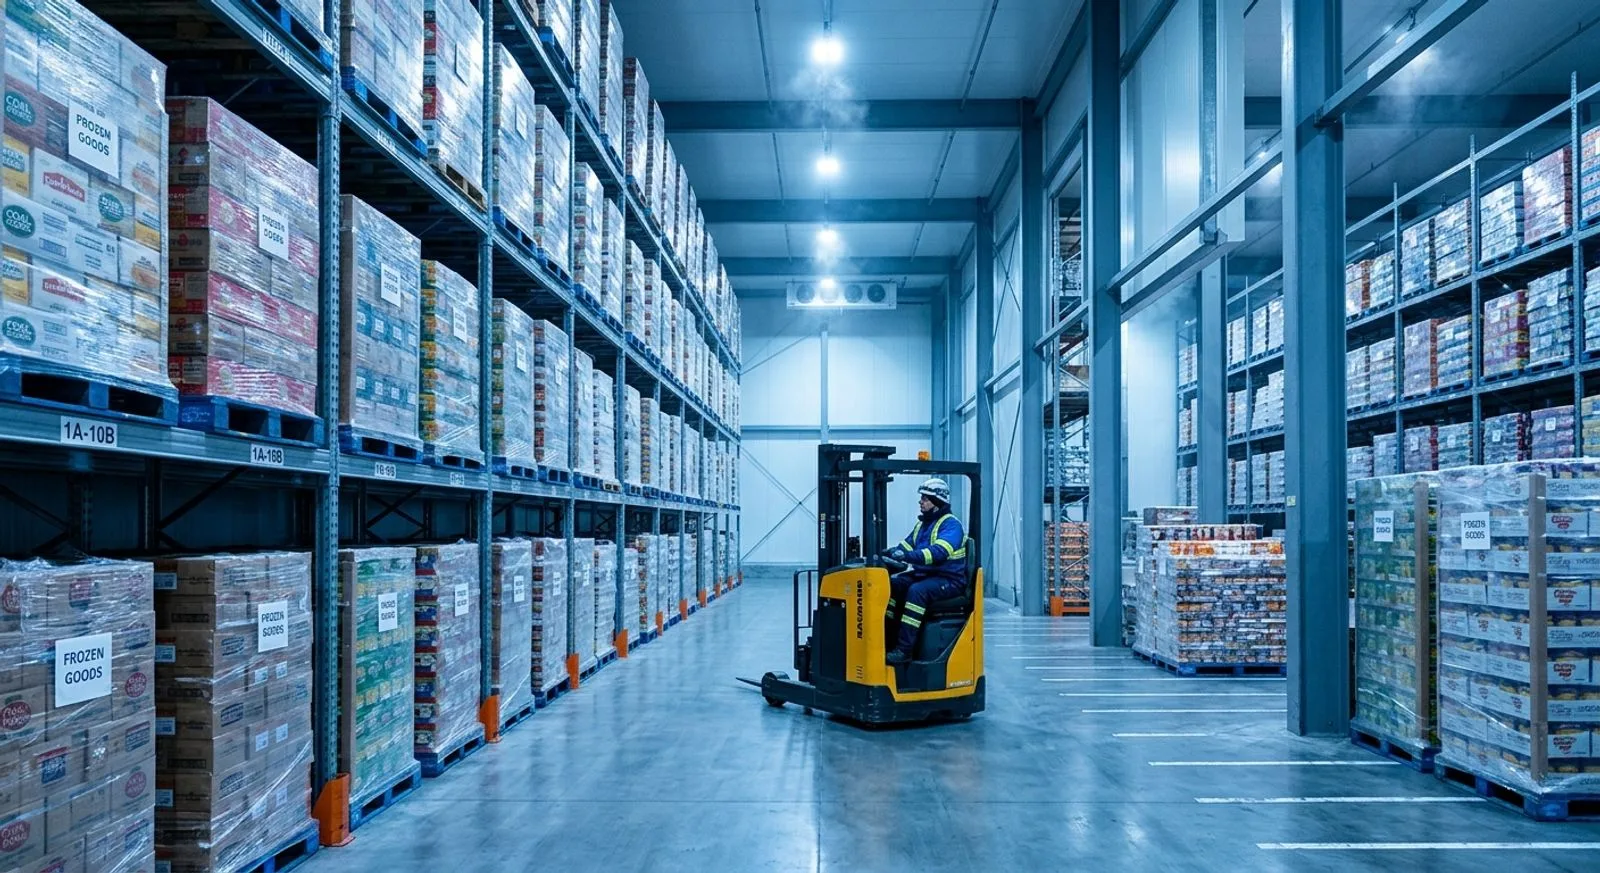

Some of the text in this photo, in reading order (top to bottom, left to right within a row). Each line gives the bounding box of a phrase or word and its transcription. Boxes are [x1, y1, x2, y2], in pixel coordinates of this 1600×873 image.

[64, 421, 115, 444] 1A-10B
[64, 647, 104, 666] FROZEN
[65, 666, 103, 685] GOODS
